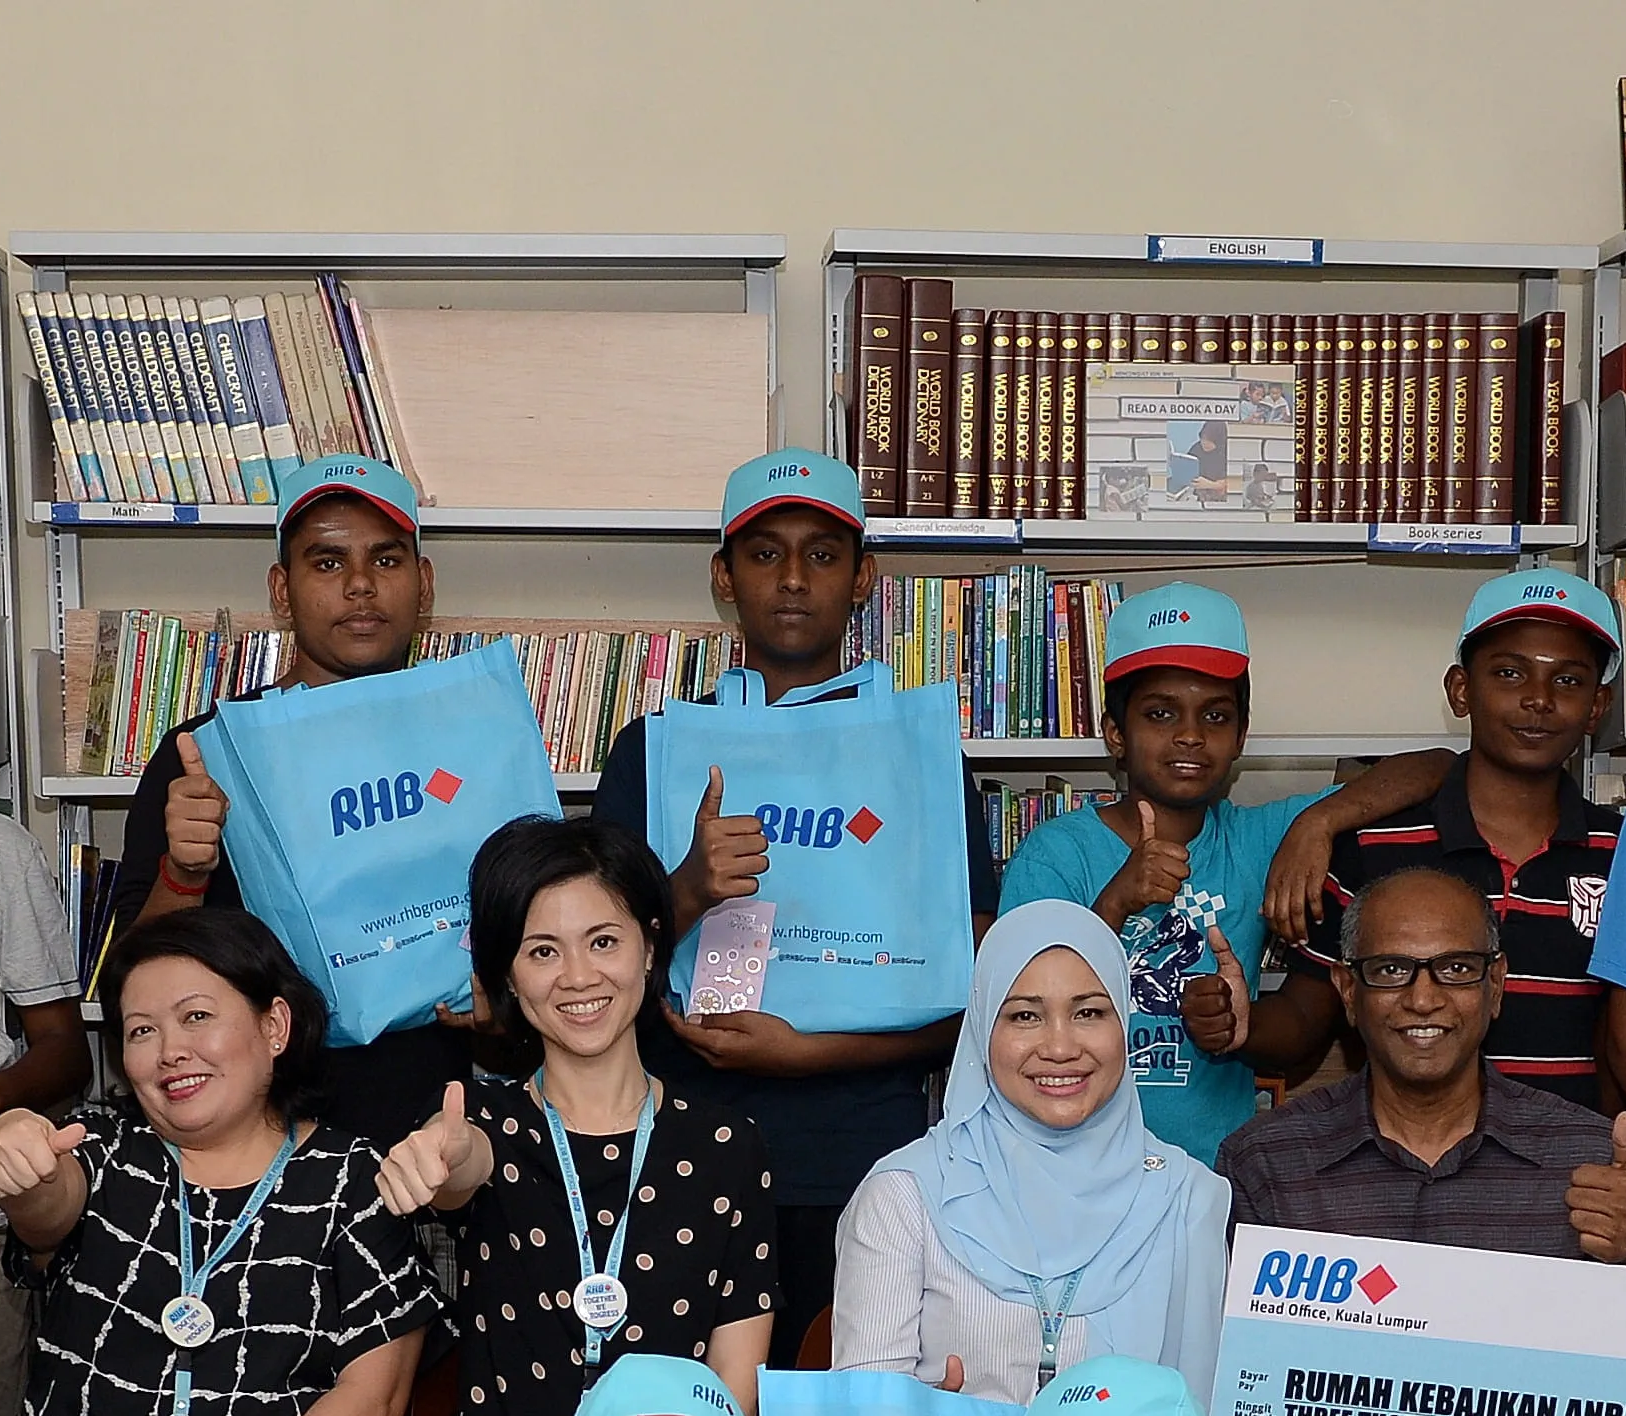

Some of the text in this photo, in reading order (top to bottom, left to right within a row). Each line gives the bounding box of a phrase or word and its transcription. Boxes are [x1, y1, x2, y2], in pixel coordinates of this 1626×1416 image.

[1209, 243, 1267, 255] ENGLISH
[866, 365, 879, 441] DICTIONARY
[878, 366, 891, 453] WORLD BOOK
[916, 369, 929, 445] DICTIONARY
[928, 369, 942, 456] WORLD BOOK
[960, 372, 975, 459] WORLD BOOK
[1127, 404, 1237, 414] READ A BOOK A DAY
[1062, 376, 1076, 463] WORLD BOOK
[1337, 378, 1351, 464] WORLD BOOK
[1489, 376, 1504, 464] WORLD BOOK
[1546, 381, 1559, 457] YEAR BOOK
[324, 466, 355, 479] RHB
[768, 464, 799, 481] RHB
[112, 506, 140, 519] Math
[895, 521, 985, 535] General knowledge
[1408, 527, 1482, 540] Book series
[1523, 585, 1555, 600] RHB
[1148, 609, 1177, 629] RHB
[330, 771, 425, 837] RHB
[755, 804, 844, 850] RHB
[1253, 1250, 1358, 1304] RHB
[582, 1294, 618, 1306] TOGETHER
[173, 1308, 201, 1333] TOGETHER
[1250, 1300, 1428, 1331] Head Office, Kuala Lumpur
[184, 1320, 212, 1344] PROGRESS
[1238, 1381, 1254, 1393] Pay
[1240, 1370, 1269, 1383] Bayar
[1285, 1368, 1394, 1409] RUMAH
[693, 1384, 725, 1409] RHB
[1060, 1385, 1097, 1406] RHB
[1235, 1400, 1272, 1415] Ringgit
